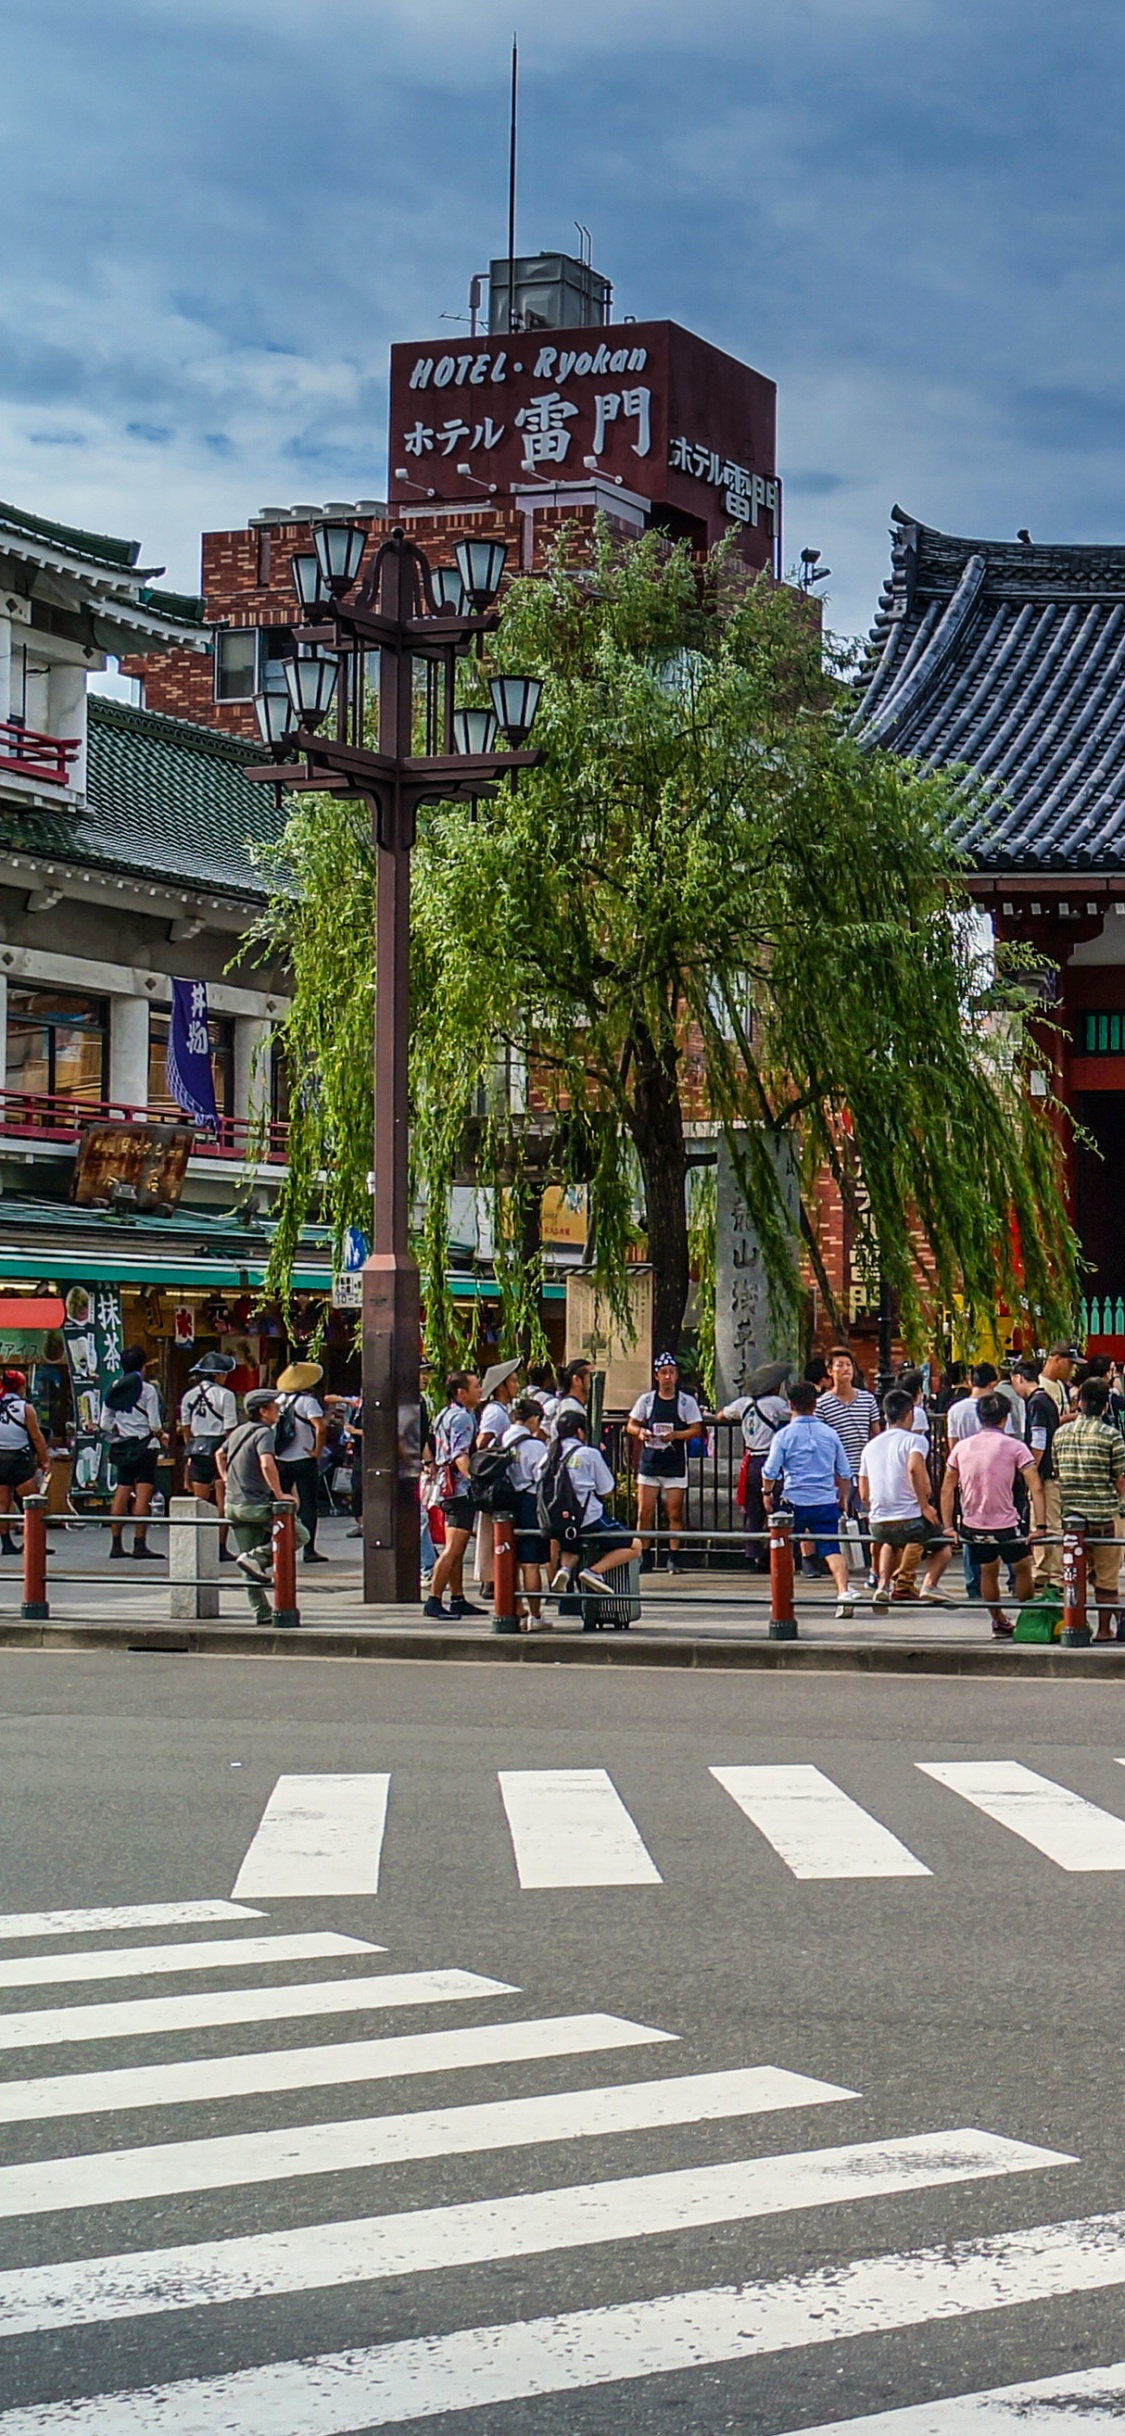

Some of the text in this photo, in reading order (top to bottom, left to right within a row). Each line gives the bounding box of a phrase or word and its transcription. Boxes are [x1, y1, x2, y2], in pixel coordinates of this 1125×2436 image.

[409, 352, 507, 390] HOTEL
[533, 343, 648, 384] Ryokan
[186, 983, 209, 1055] 丼物
[0, 1341, 40, 1362] アイス
[97, 1293, 122, 1373] 抹茶
